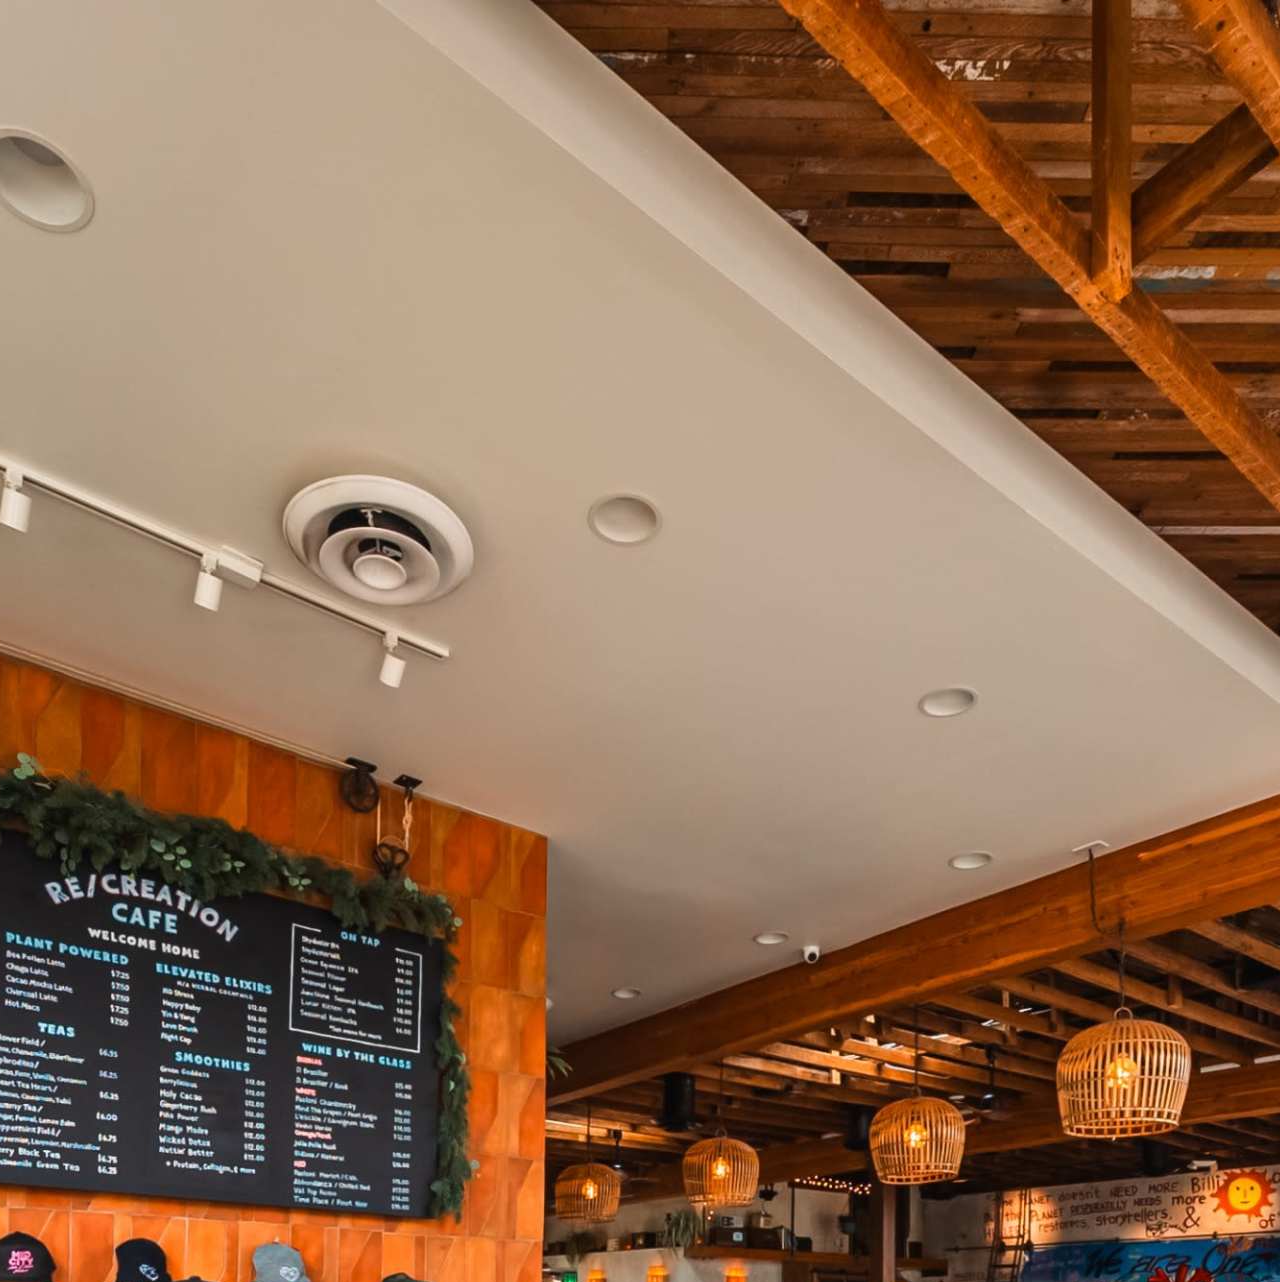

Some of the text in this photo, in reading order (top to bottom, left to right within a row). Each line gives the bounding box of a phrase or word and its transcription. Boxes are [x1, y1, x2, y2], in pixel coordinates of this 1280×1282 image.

[45, 873, 239, 942] RE/CREATION
[111, 903, 178, 934] CAFE
[5, 931, 129, 966] PLANT POWERED
[88, 927, 200, 960] WELCOME HOME
[340, 930, 380, 947] ON TAP
[155, 962, 220, 984] ELEVATED
[225, 977, 273, 995] ELIXIRS
[38, 1022, 75, 1037] TEAS
[175, 1051, 250, 1072] SMOOTHIES
[302, 1042, 331, 1056] WINE
[336, 1047, 350, 1058] BY
[354, 1050, 375, 1063] THE
[1148, 1181, 1180, 1194] MORE
[1171, 1194, 1207, 1206] more
[8, 1257, 34, 1268] CITY
[10, 1250, 31, 1260] MID
